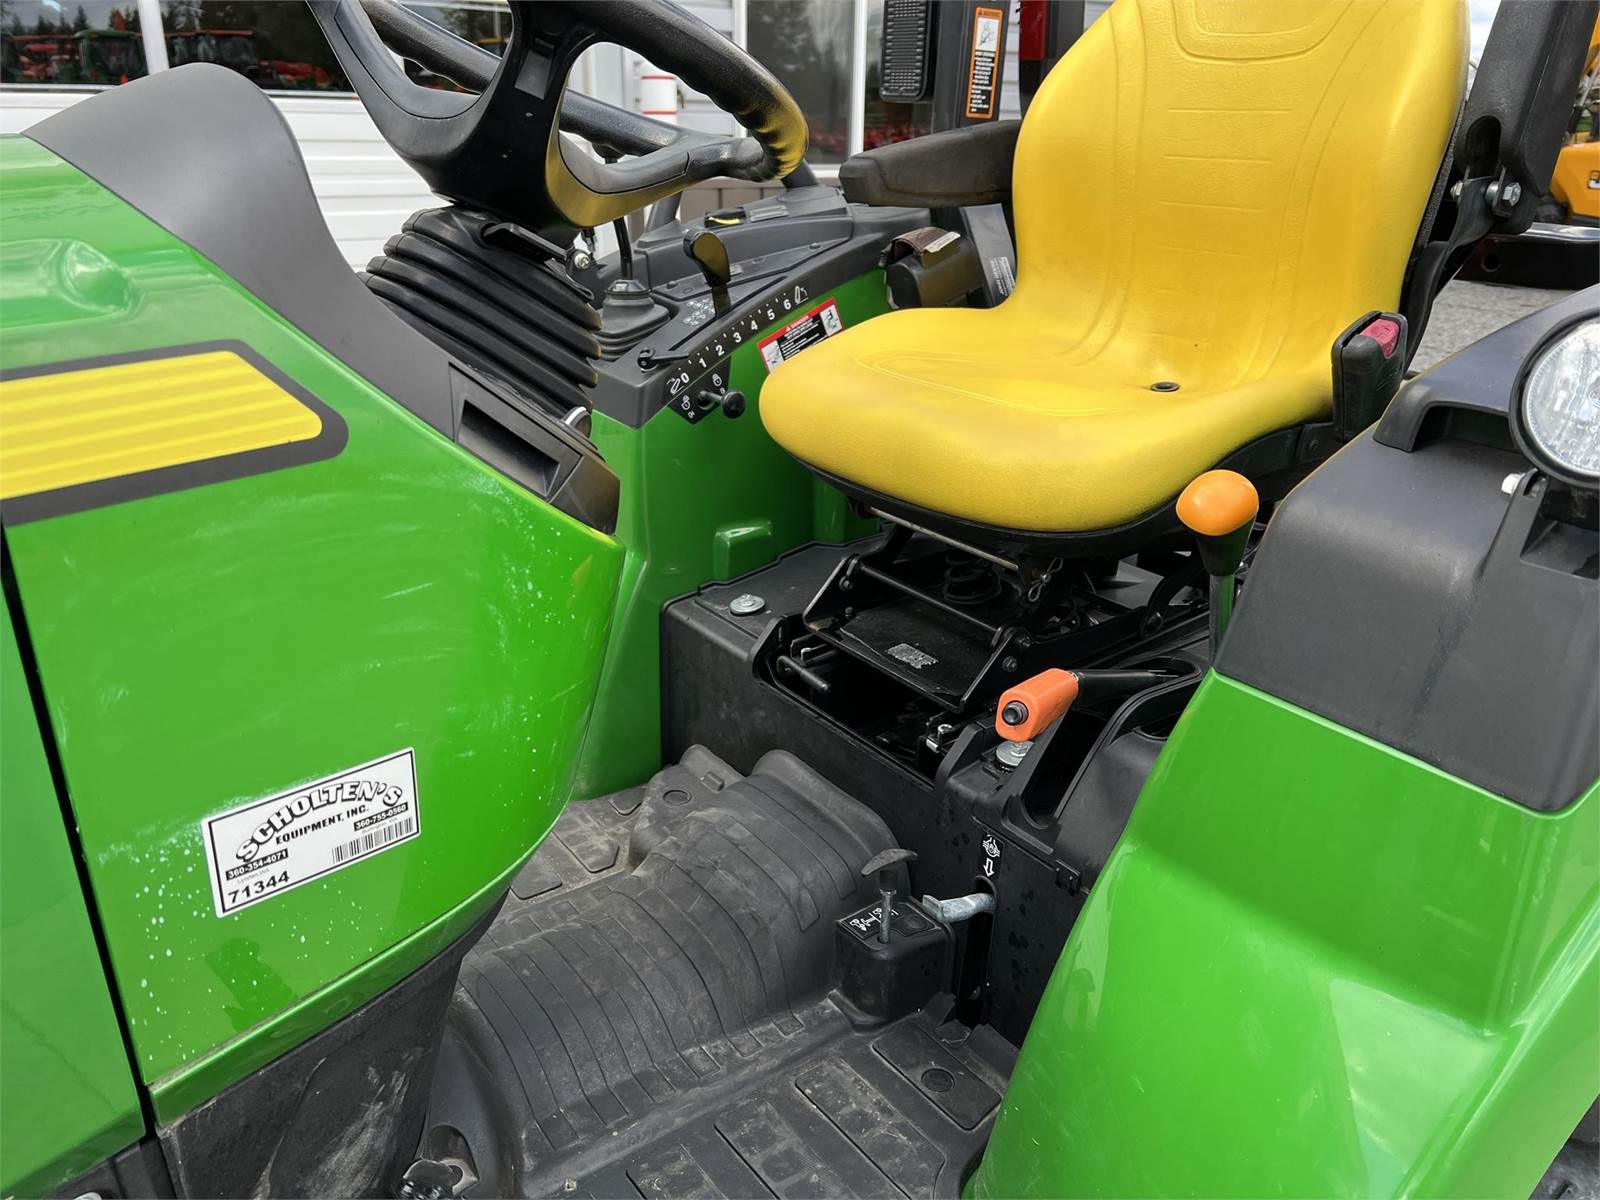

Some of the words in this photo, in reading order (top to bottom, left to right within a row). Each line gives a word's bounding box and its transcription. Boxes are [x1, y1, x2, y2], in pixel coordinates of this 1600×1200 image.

[699, 358, 707, 368] 1
[716, 345, 725, 356] 2
[733, 332, 742, 343] 3
[750, 320, 758, 331] 4
[767, 309, 776, 320] 5
[783, 299, 792, 310] 6
[235, 780, 403, 863] SCHOLTEN'S
[347, 804, 370, 819] INC.
[228, 850, 286, 879] 360-354-4071
[228, 870, 290, 903] 71344
